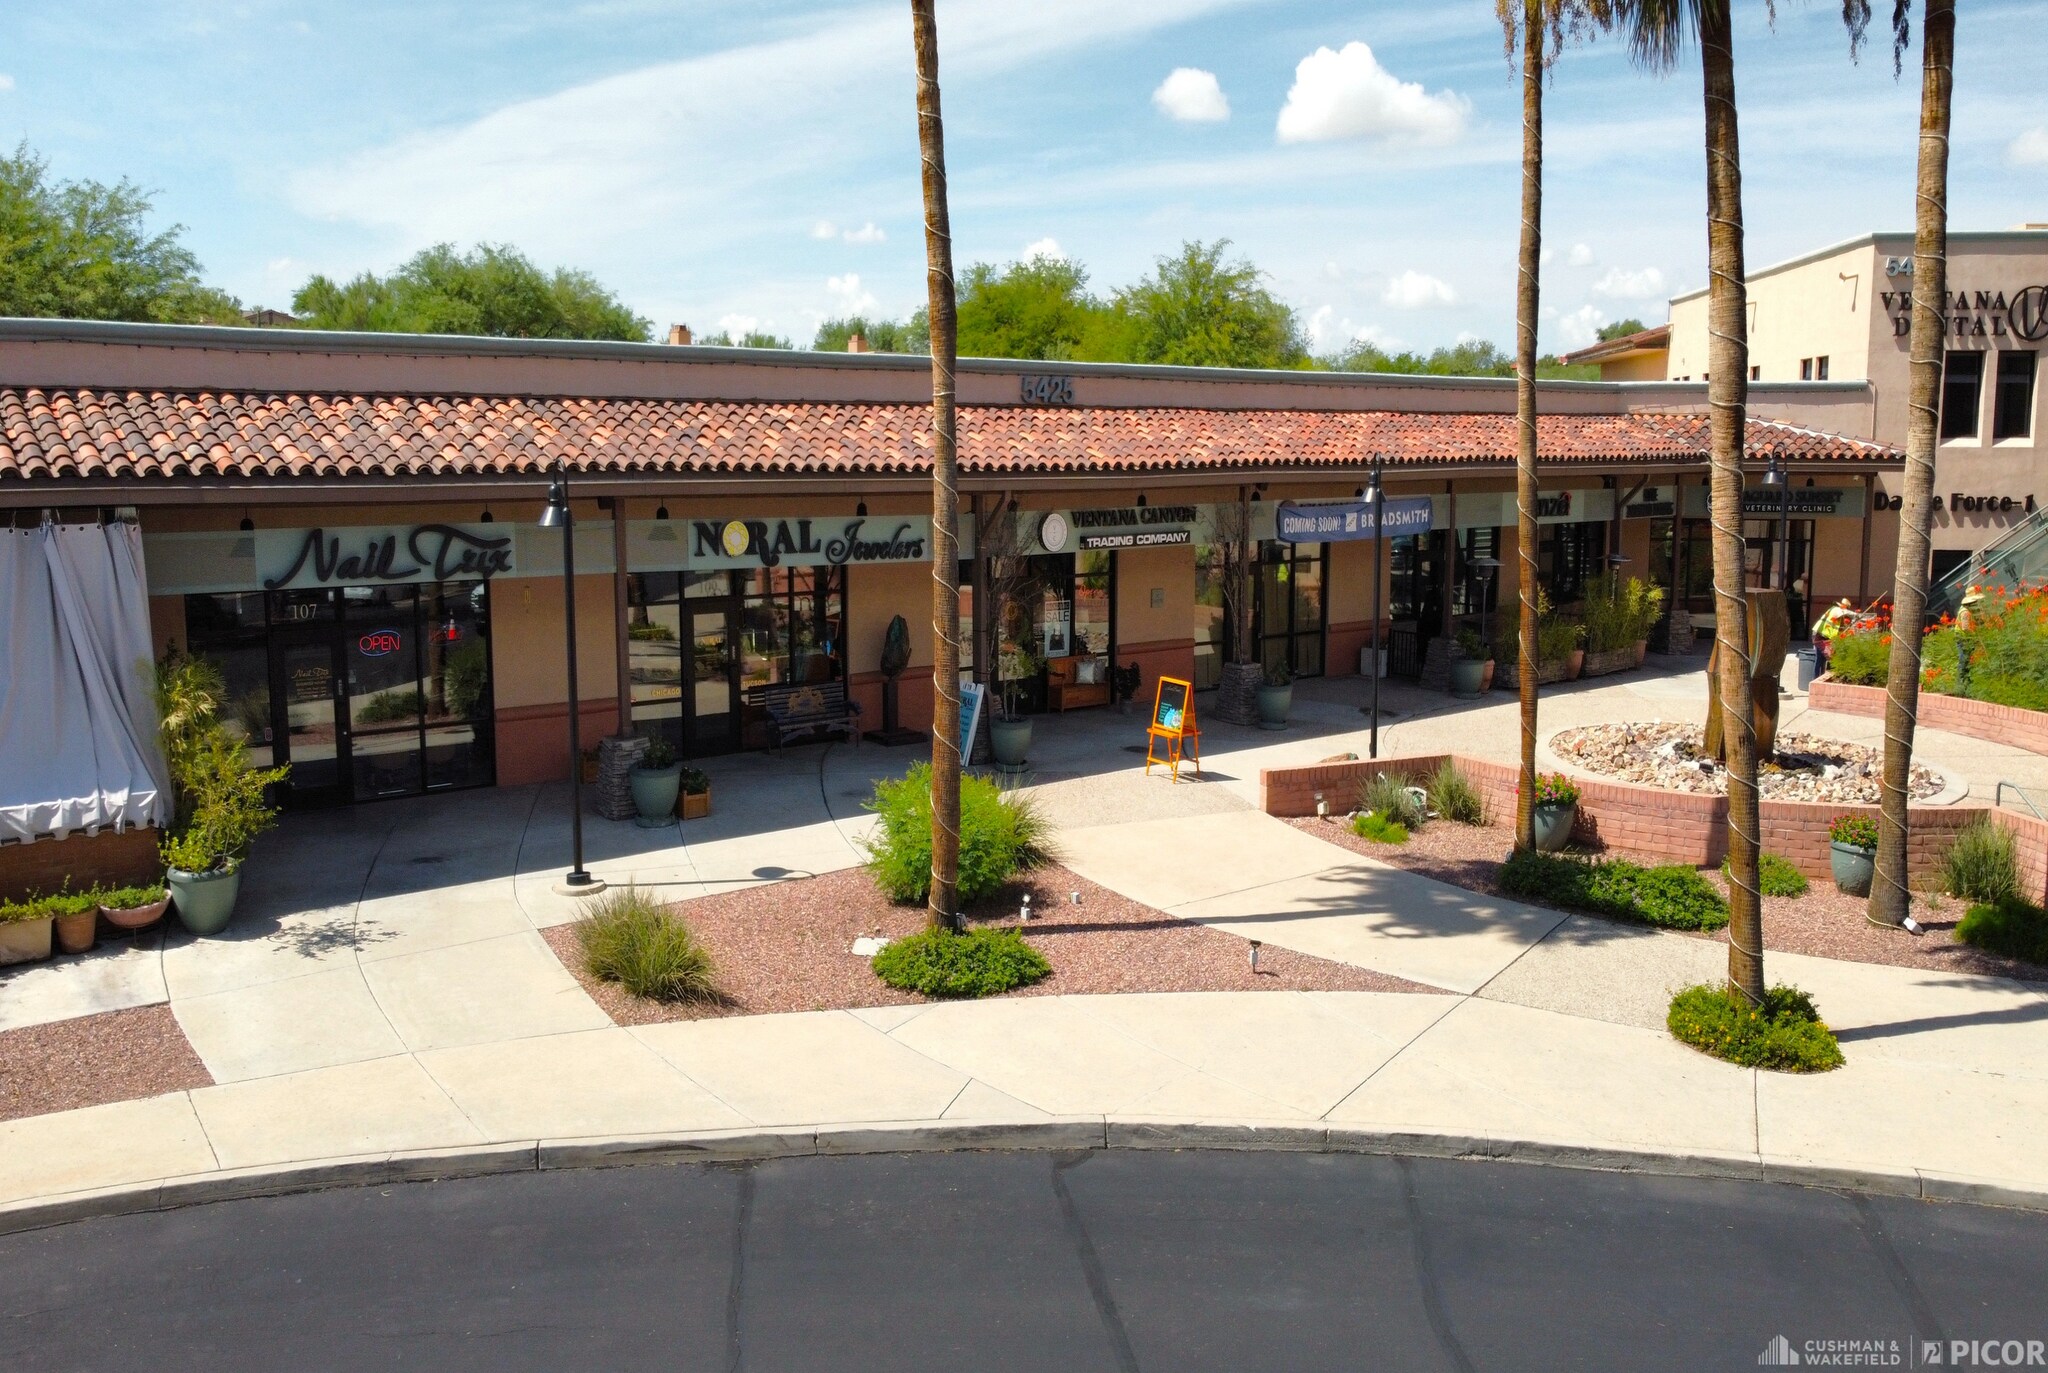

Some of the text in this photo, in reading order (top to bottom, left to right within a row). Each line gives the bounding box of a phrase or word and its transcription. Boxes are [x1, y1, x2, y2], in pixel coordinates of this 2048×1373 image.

[1880, 291, 2008, 311] VETANA
[1892, 316, 2007, 337] DTAL
[1021, 376, 1075, 403] 5425
[1745, 504, 1832, 512] VETERINRY CLINIC
[1873, 492, 2034, 513] Dae Force-1
[1071, 506, 1197, 528] VENTANA CANYON
[1284, 508, 1429, 533] COMING SOON! BRADSMITH
[693, 519, 926, 567] NORAL Jewelers
[1087, 532, 1188, 548] TRADING COMPANY
[264, 524, 512, 589] Nail Trix
[291, 603, 318, 619] 107
[1046, 611, 1070, 623] SALE
[359, 635, 400, 651] OPEN
[651, 687, 680, 697] CHICAGO
